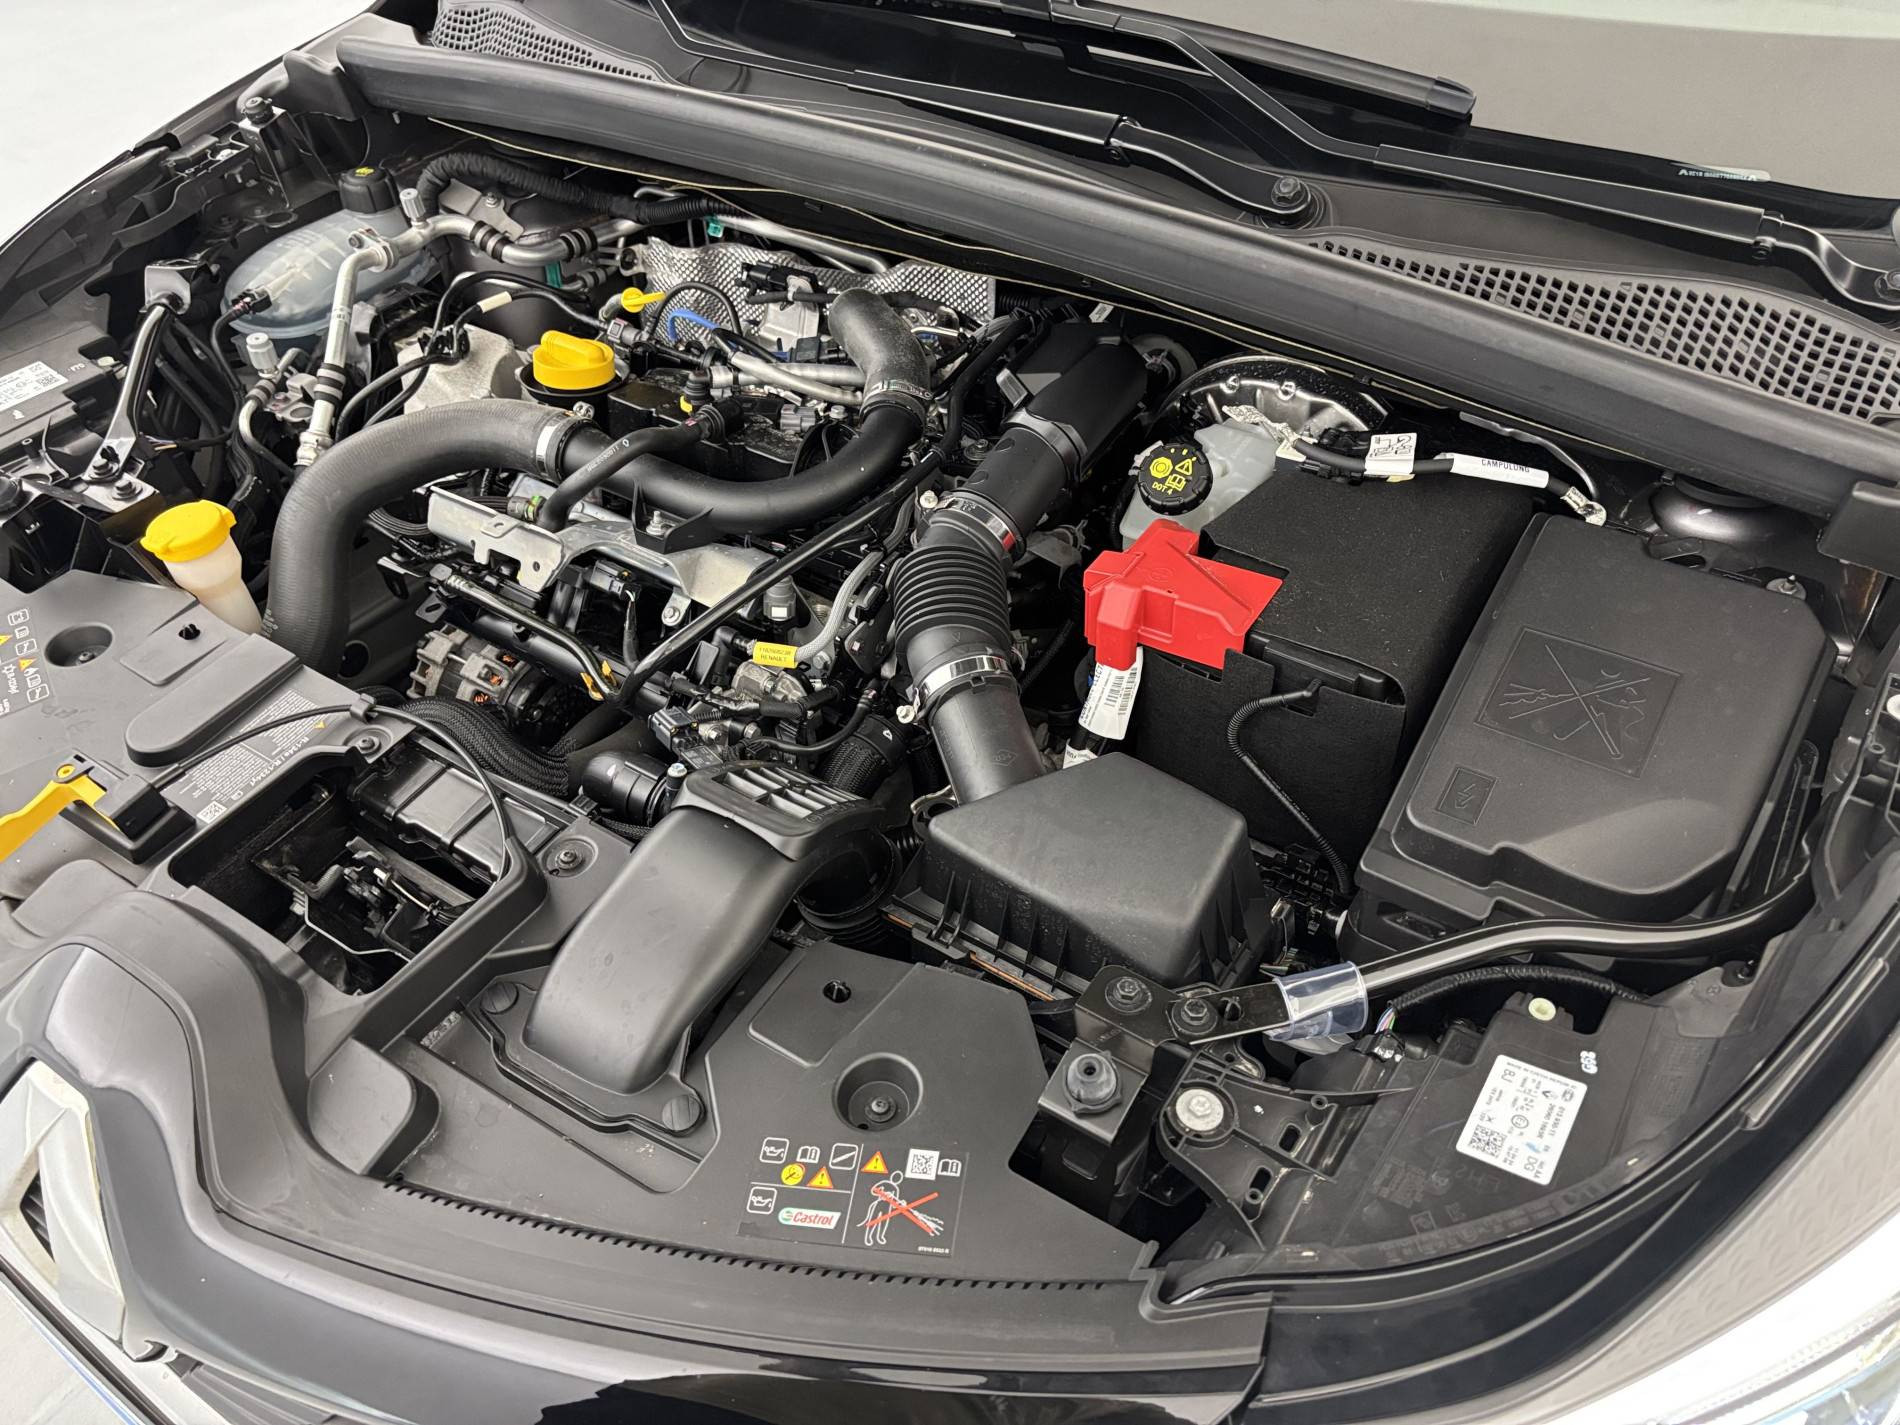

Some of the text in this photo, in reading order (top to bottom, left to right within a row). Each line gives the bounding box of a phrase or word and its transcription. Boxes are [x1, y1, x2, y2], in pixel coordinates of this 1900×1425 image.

[1152, 481, 1167, 492] DOT
[1522, 1155, 1538, 1172] DG
[793, 1211, 834, 1226] Castrol
